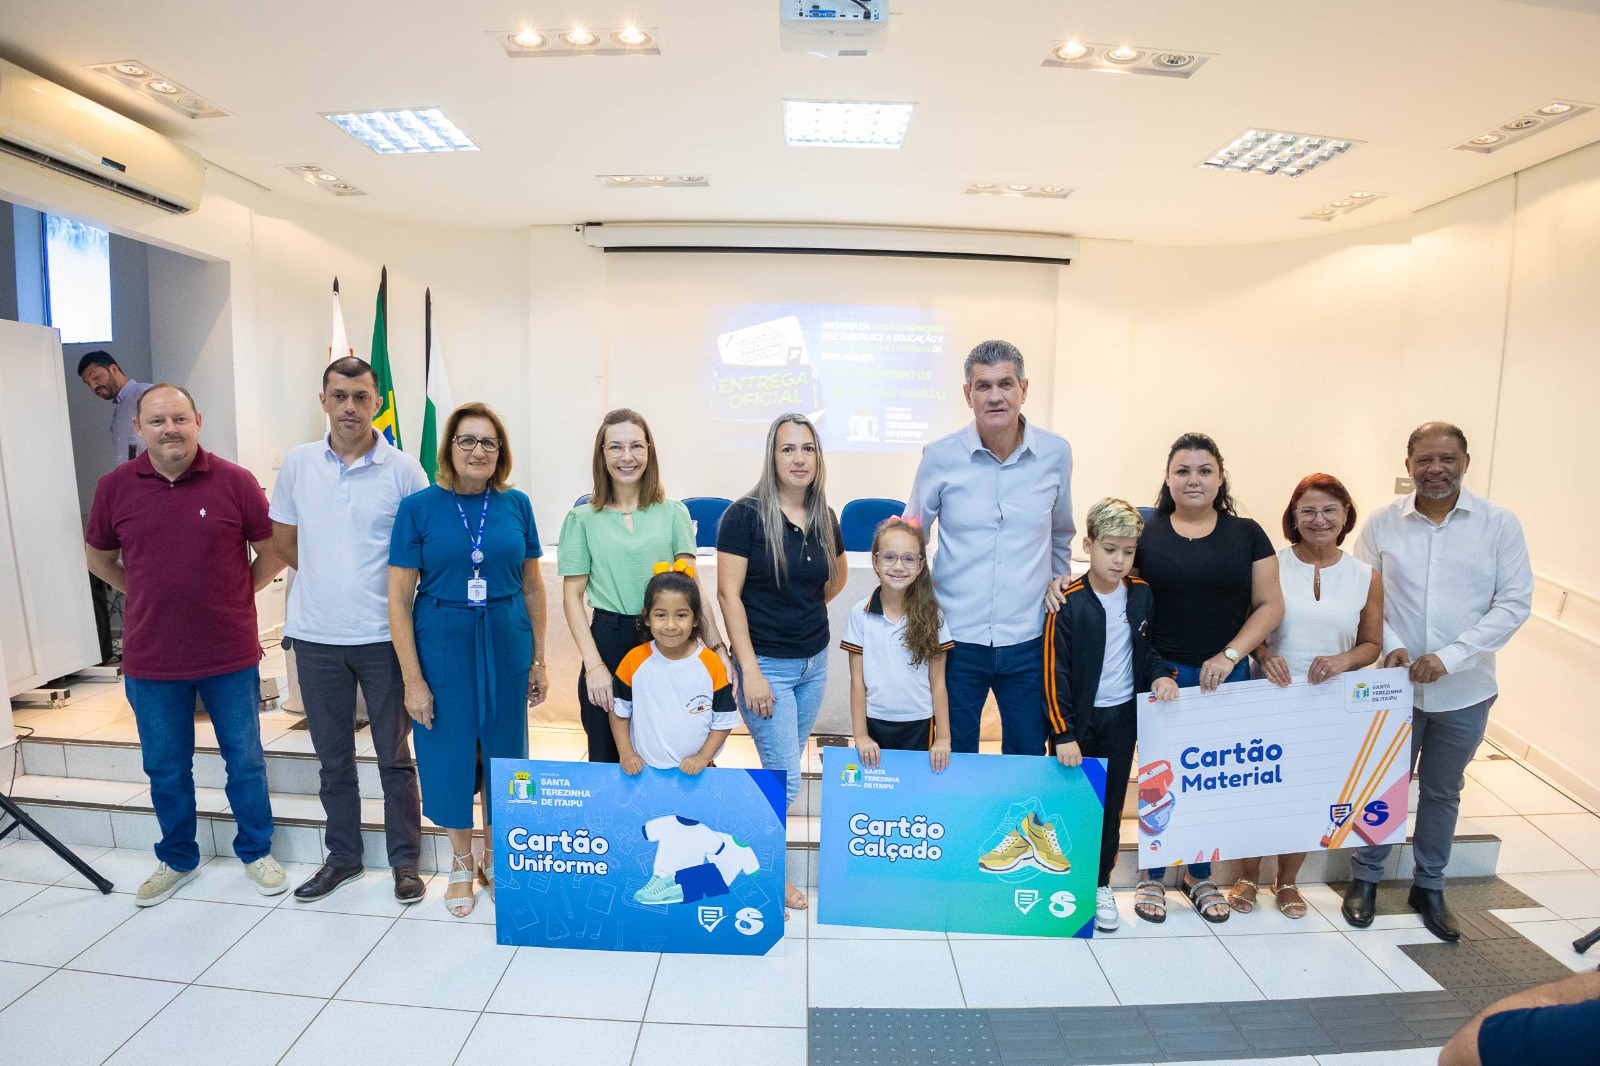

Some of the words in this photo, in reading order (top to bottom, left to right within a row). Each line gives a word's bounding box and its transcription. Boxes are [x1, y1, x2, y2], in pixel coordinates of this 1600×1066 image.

[893, 333, 937, 344] EDUCAÇÃO
[931, 345, 943, 353] DA
[719, 371, 808, 393] ENTREGA
[728, 388, 802, 409] OFICIAL
[1180, 738, 1283, 770] Cartão
[540, 778, 571, 787] SANTA
[864, 775, 900, 783] TEREZINHA
[1181, 764, 1283, 793] Material
[541, 788, 591, 798] TEREZINHA
[541, 798, 553, 806] DE
[554, 798, 583, 808] ITAIPU
[849, 812, 945, 840] Cartão
[507, 827, 609, 855] Cartão
[848, 837, 943, 862] Calçado
[508, 853, 609, 875] Uniforme
